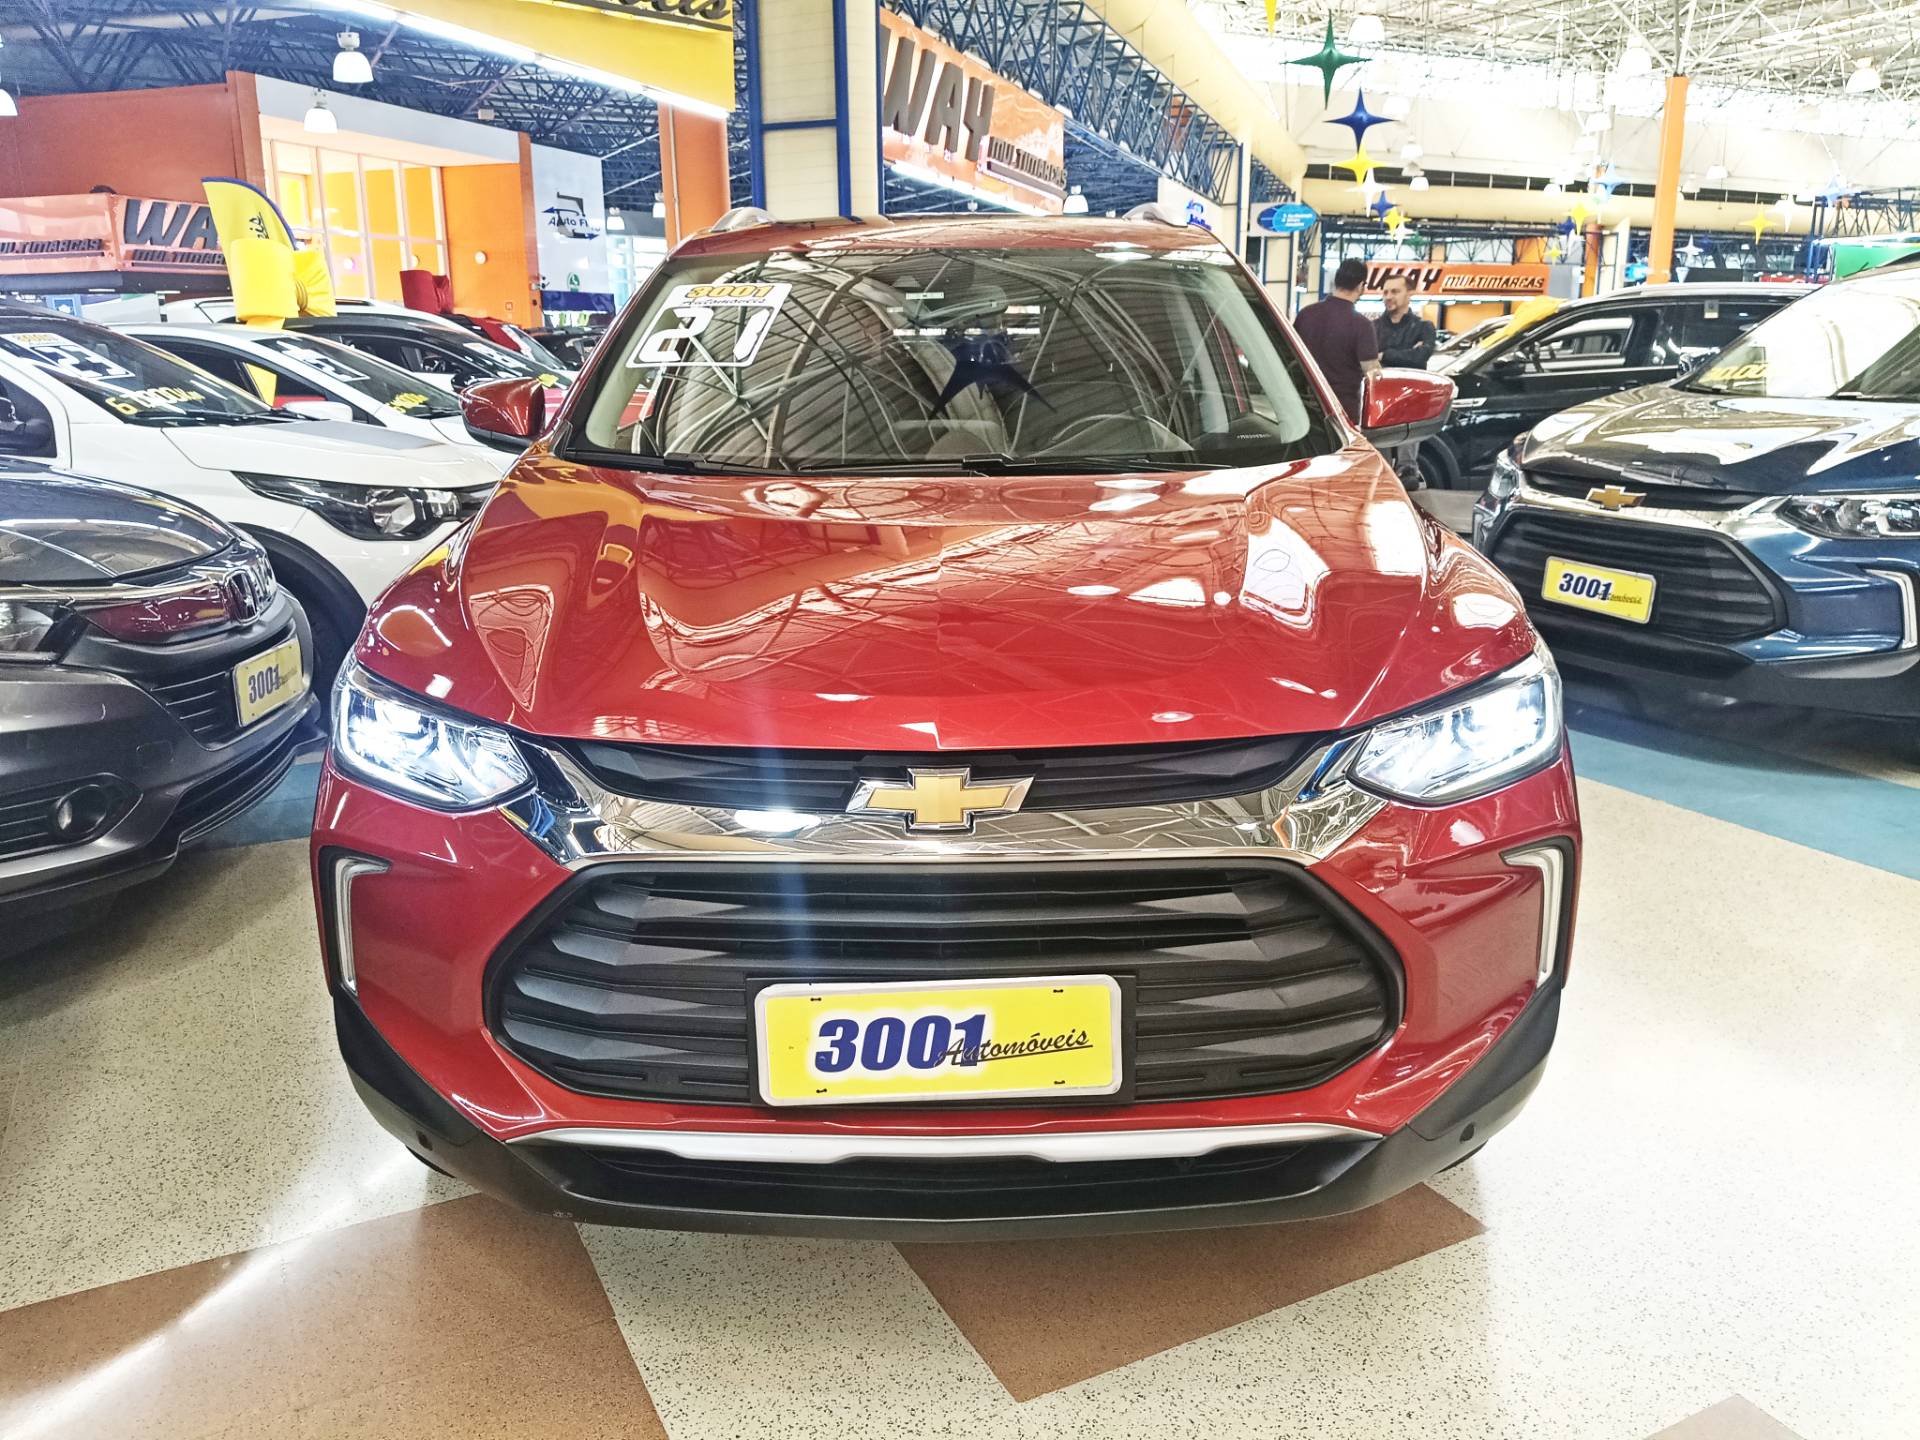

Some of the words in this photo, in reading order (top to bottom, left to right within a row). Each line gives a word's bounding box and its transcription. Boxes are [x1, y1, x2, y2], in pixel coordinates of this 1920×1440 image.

[880, 23, 995, 163] WAY
[124, 198, 220, 250] WA
[685, 285, 774, 299] 3001
[638, 308, 770, 362] 21
[1558, 572, 1613, 601] 3001
[248, 663, 280, 704] 3001
[814, 1013, 986, 1073] 3001
[934, 1028, 1094, 1067] Automóveis
